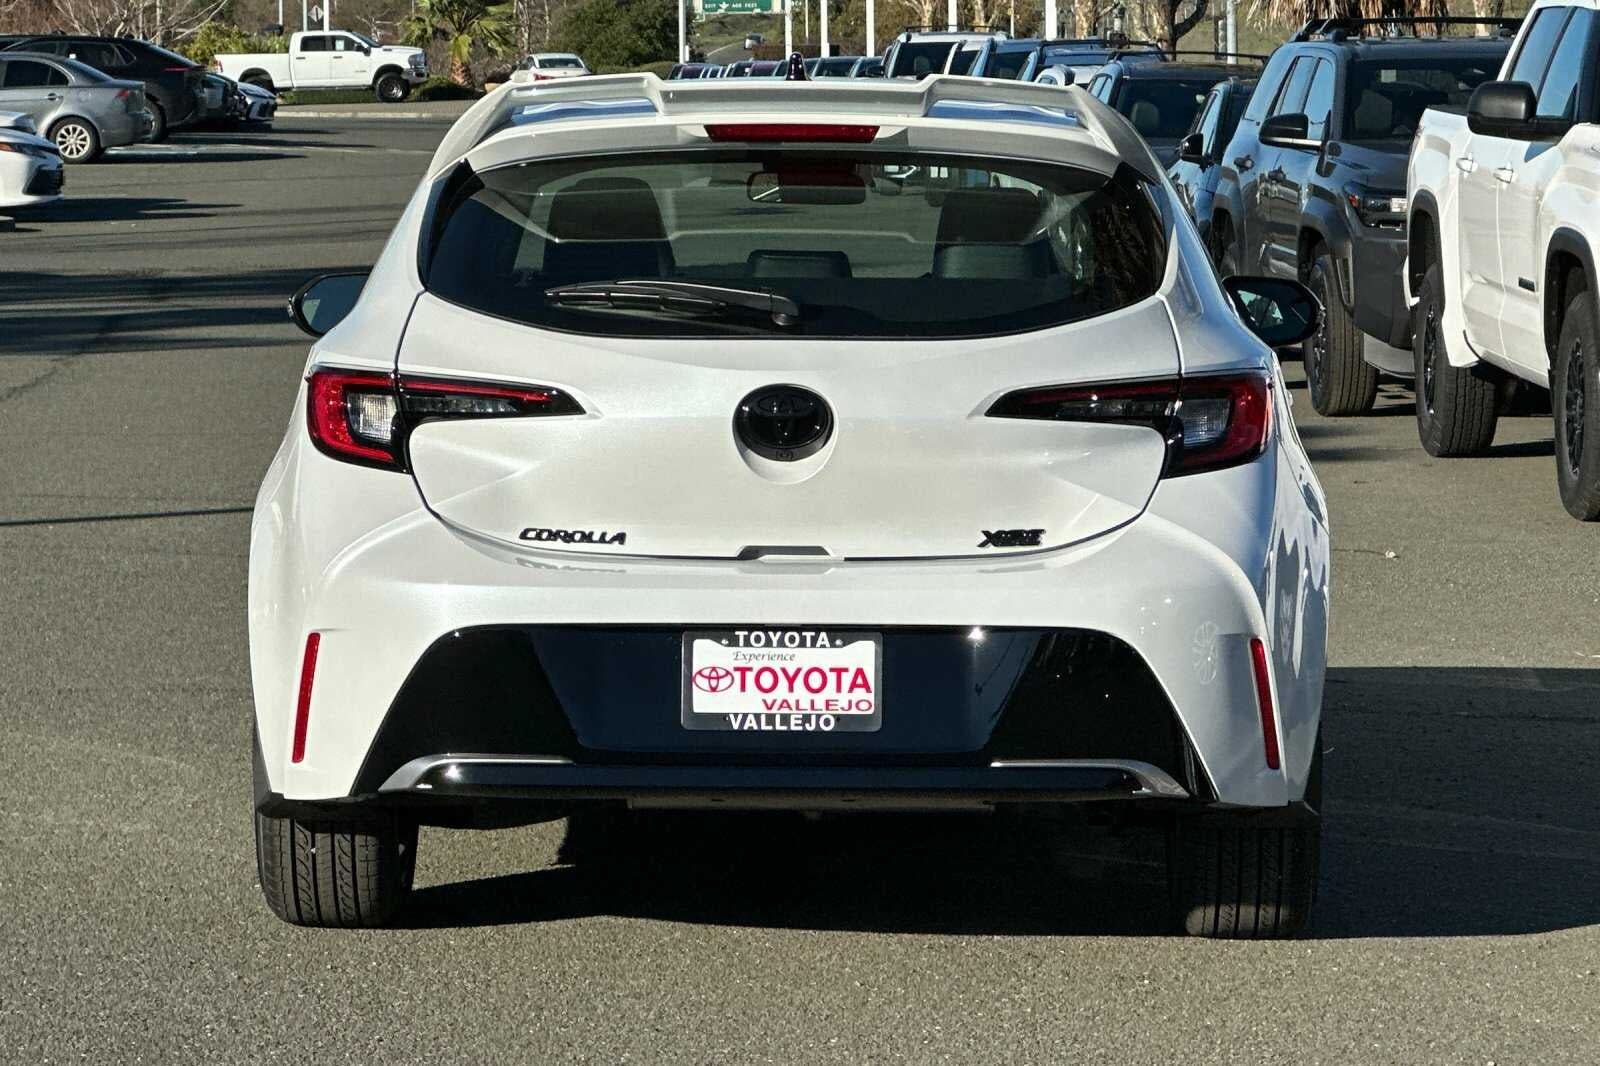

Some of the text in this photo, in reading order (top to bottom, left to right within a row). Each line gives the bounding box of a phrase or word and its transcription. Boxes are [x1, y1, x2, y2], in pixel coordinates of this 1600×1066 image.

[519, 528, 627, 545] COROLLA
[734, 631, 831, 648] TOYOTA
[732, 651, 796, 664] Experience
[733, 666, 873, 694] TOYOTA
[761, 698, 873, 712] VALLEJO
[729, 714, 835, 731] VALLEJO
